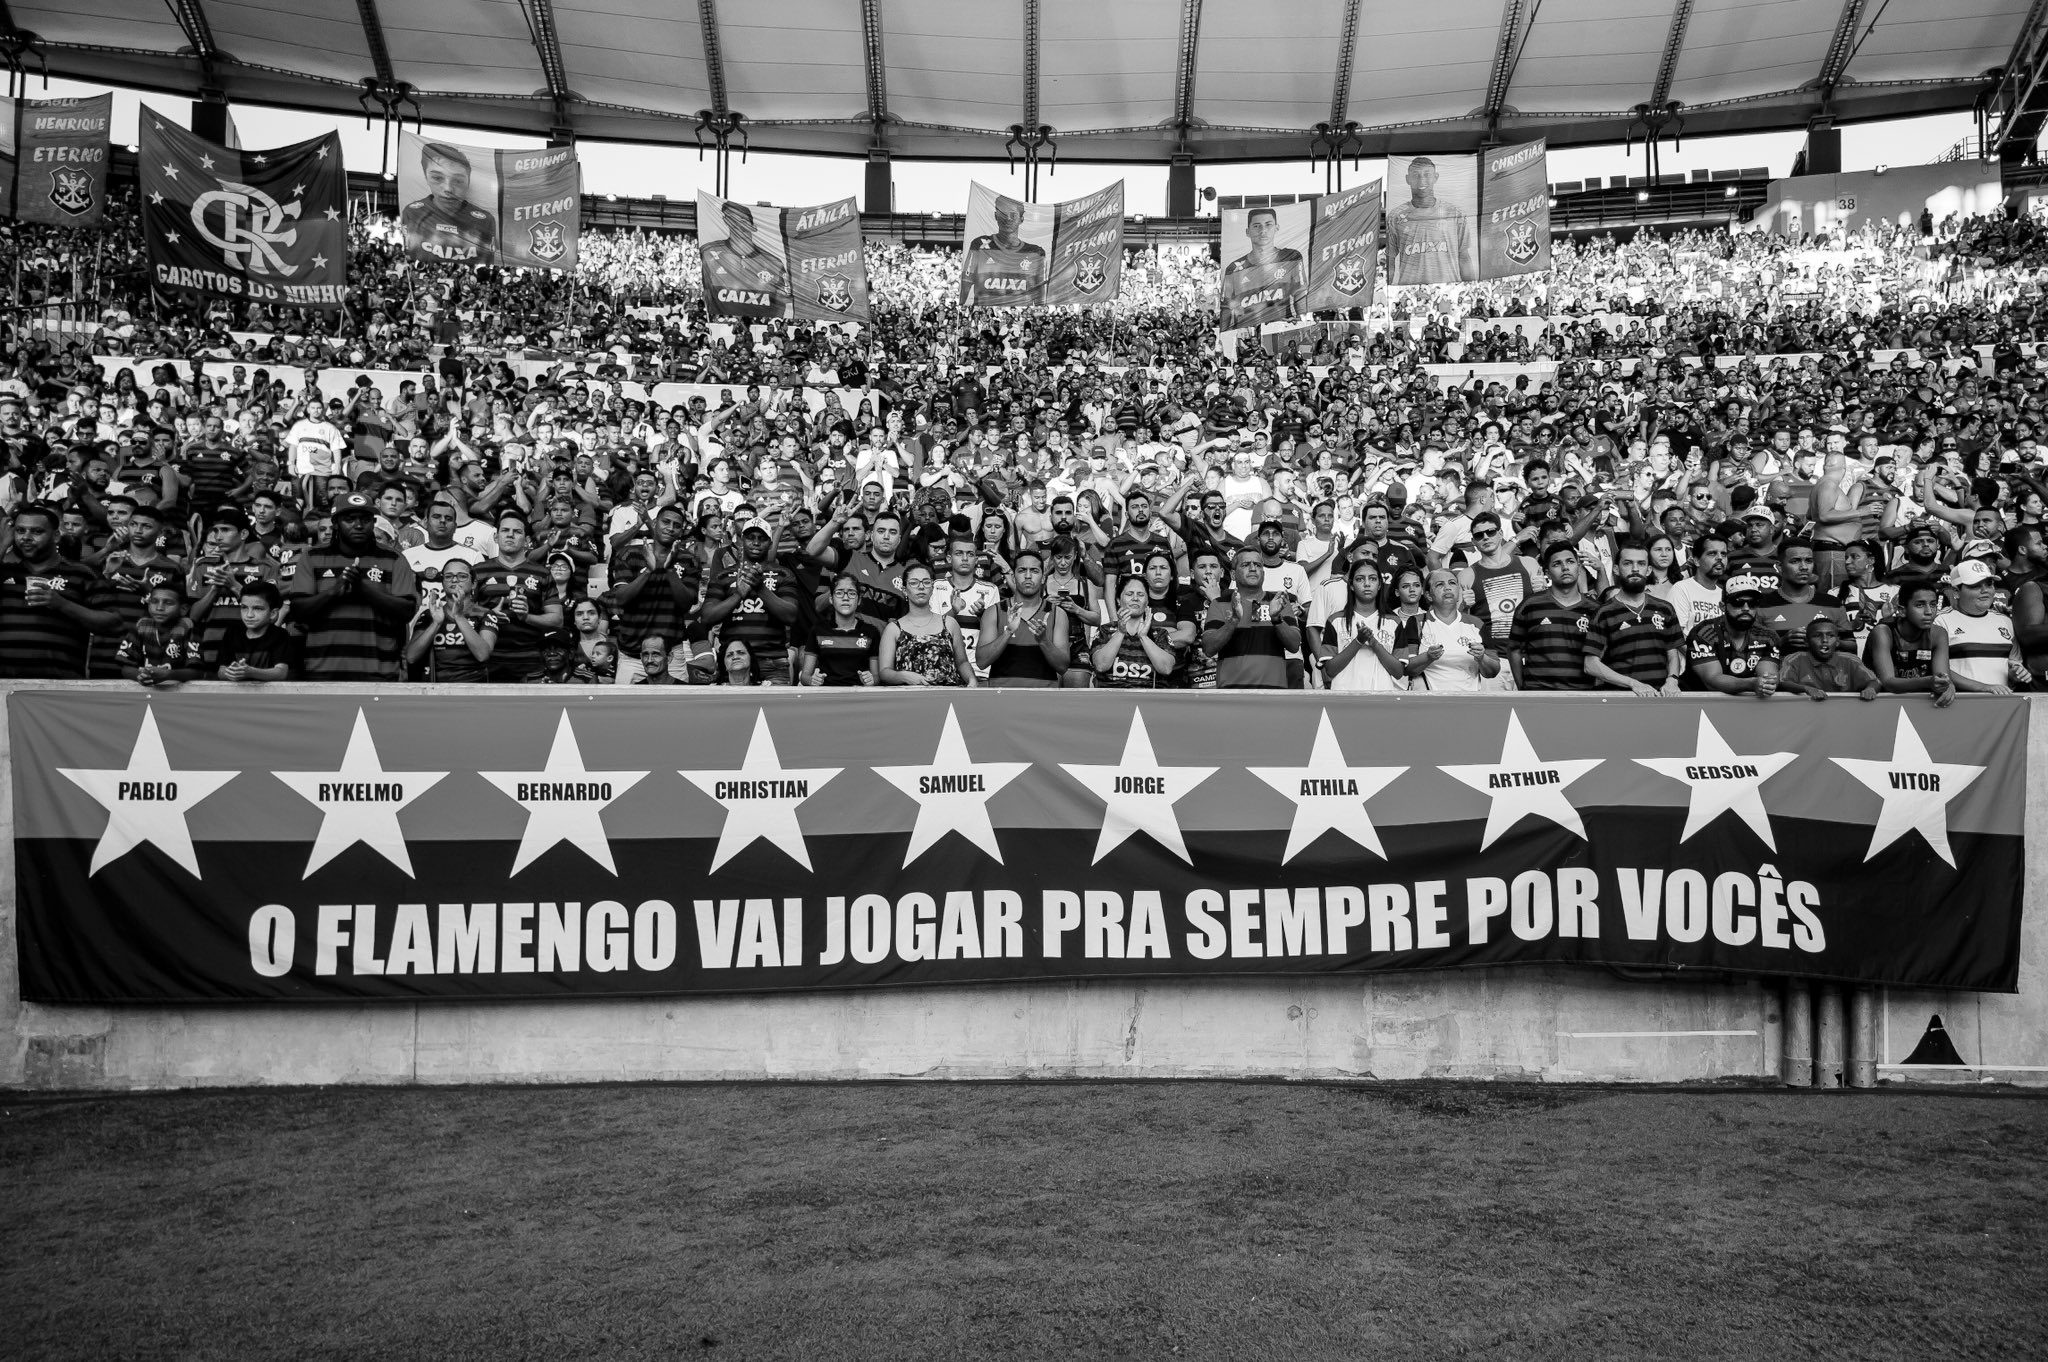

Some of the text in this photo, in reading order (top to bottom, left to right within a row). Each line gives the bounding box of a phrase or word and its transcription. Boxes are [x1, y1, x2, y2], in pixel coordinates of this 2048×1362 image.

[35, 117, 106, 131] HENRIQUE
[33, 146, 103, 162] ETERNO
[1491, 143, 1544, 172] CHRISTIAN
[513, 197, 574, 221] ETERNO
[1492, 195, 1545, 224] ETERNO
[1839, 199, 1855, 210] 38
[421, 241, 478, 261] CAIXA
[1065, 230, 1116, 256] ETERNO
[1177, 246, 1189, 256] 40
[1322, 231, 1374, 261] ETERNO
[1405, 242, 1448, 255] CAIXA
[800, 250, 858, 274] ETERNO
[156, 264, 348, 304] GAROTOS DO NINHO
[984, 278, 1026, 290] CAIXA
[717, 289, 771, 306] CAIXA
[1240, 289, 1284, 307] CAIXA
[1489, 770, 1560, 788] ARTHUR
[1685, 765, 1759, 780] GEDSON
[715, 780, 808, 799] CHRISTIAN
[919, 775, 985, 794] SAMUEL
[1114, 776, 1165, 794] JORGE
[1300, 779, 1359, 795] ATHILA
[1888, 772, 1940, 792] VITOR
[119, 782, 177, 801] PABLO
[319, 784, 403, 802] RYKELMO
[517, 783, 612, 801] BERNARDO
[249, 863, 1826, 977] O FLAMENGO VAI JOGAR PRA SEMPRE POR VOCÊS
